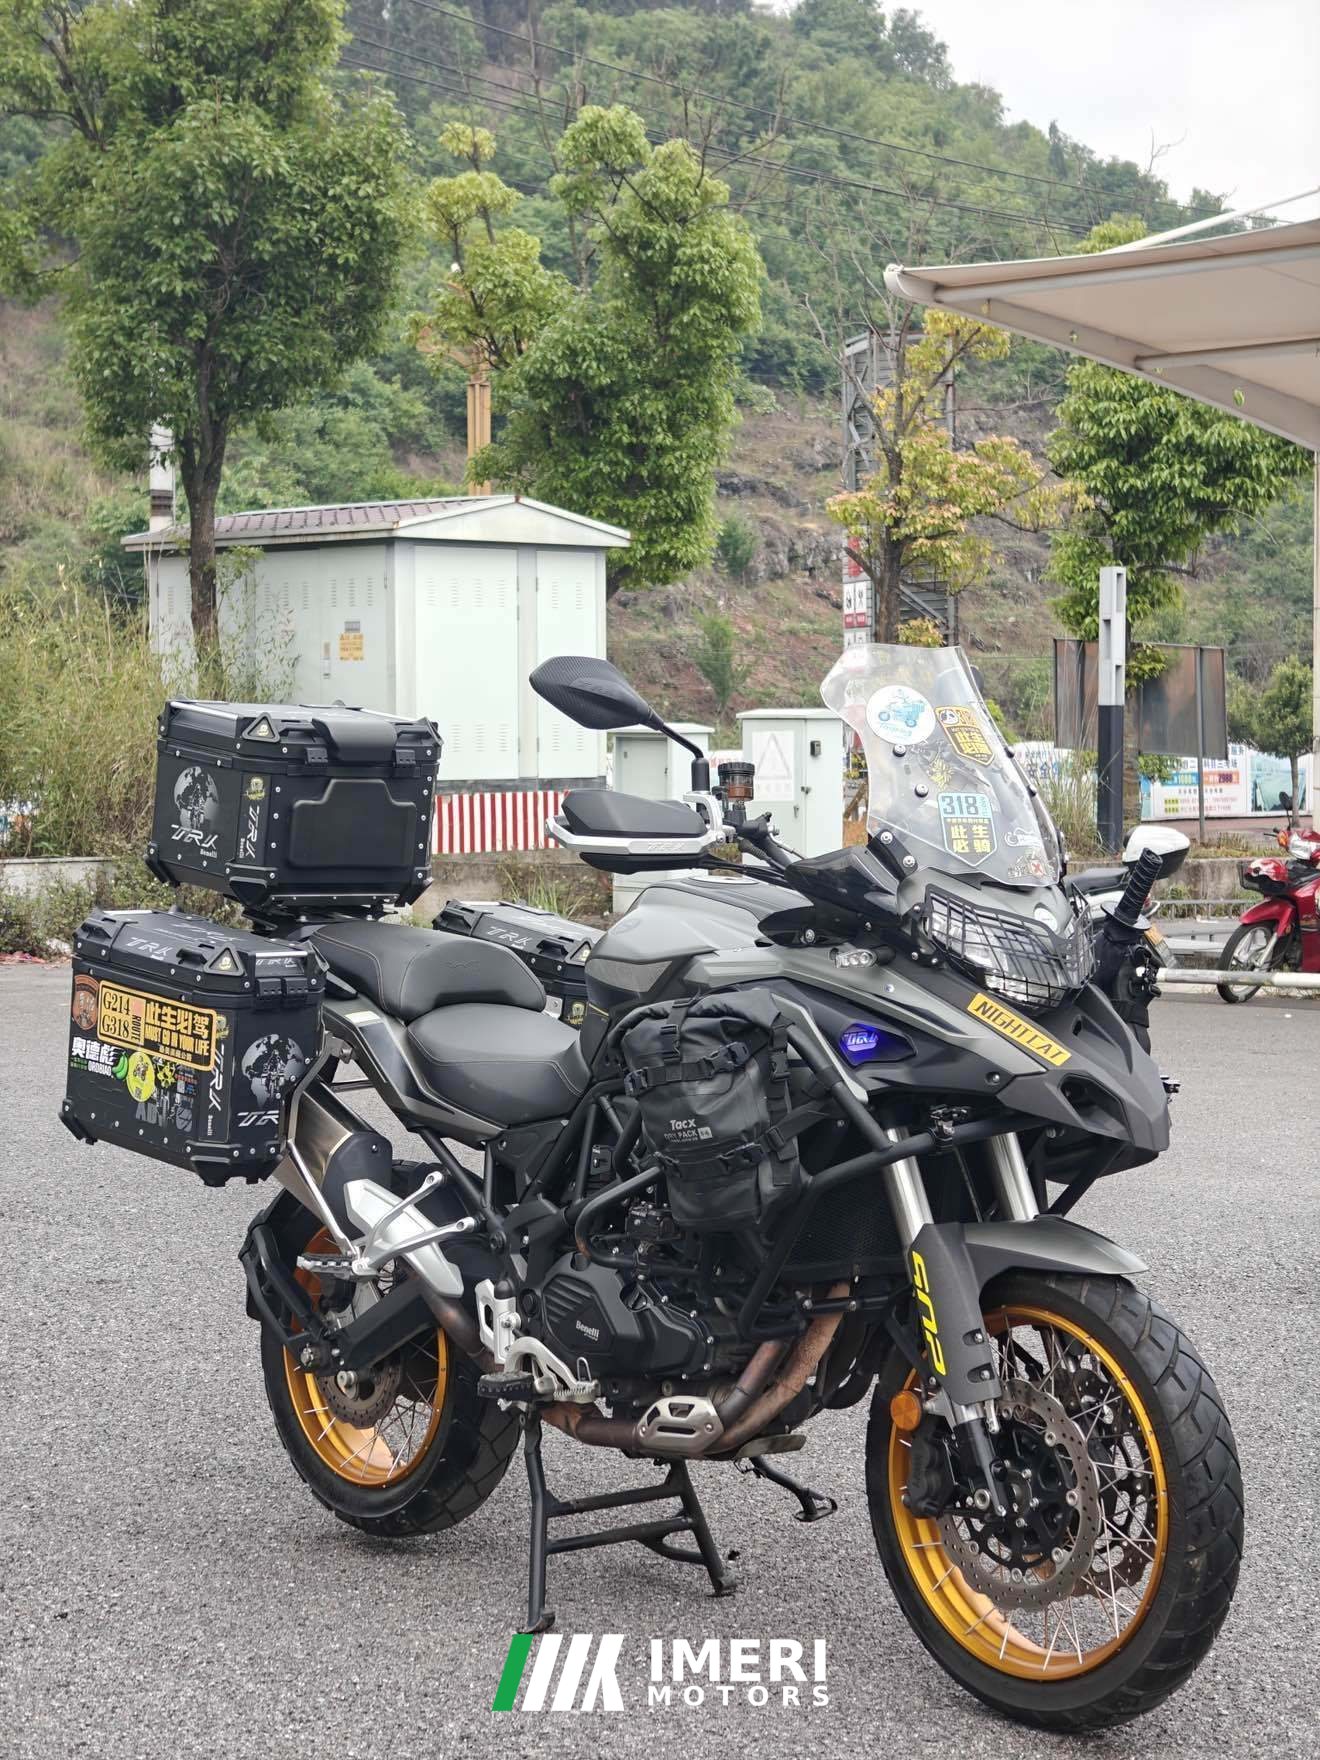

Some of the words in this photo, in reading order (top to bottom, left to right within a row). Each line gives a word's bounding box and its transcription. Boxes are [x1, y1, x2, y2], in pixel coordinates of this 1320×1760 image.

[941, 796, 979, 815] 318
[171, 824, 219, 850] TRK
[246, 805, 260, 858] TRK
[950, 825, 990, 839] 此生
[125, 937, 173, 956] TRK
[487, 926, 532, 945] TRK
[103, 991, 131, 1016] G214
[102, 1014, 130, 1039] G318
[131, 1014, 141, 1042] ROUTE
[145, 1001, 210, 1039] 此生必驾
[976, 1001, 1032, 1038] NIGHT
[1027, 1035, 1065, 1059] CAT
[71, 1036, 121, 1065] 奥德彪
[195, 1039, 209, 1056] LIFE
[208, 1043, 224, 1111] TRK
[237, 1110, 280, 1127] TR
[670, 1119, 697, 1131] Tacx
[677, 1129, 698, 1138] PACK
[576, 1320, 600, 1338] Benelli
